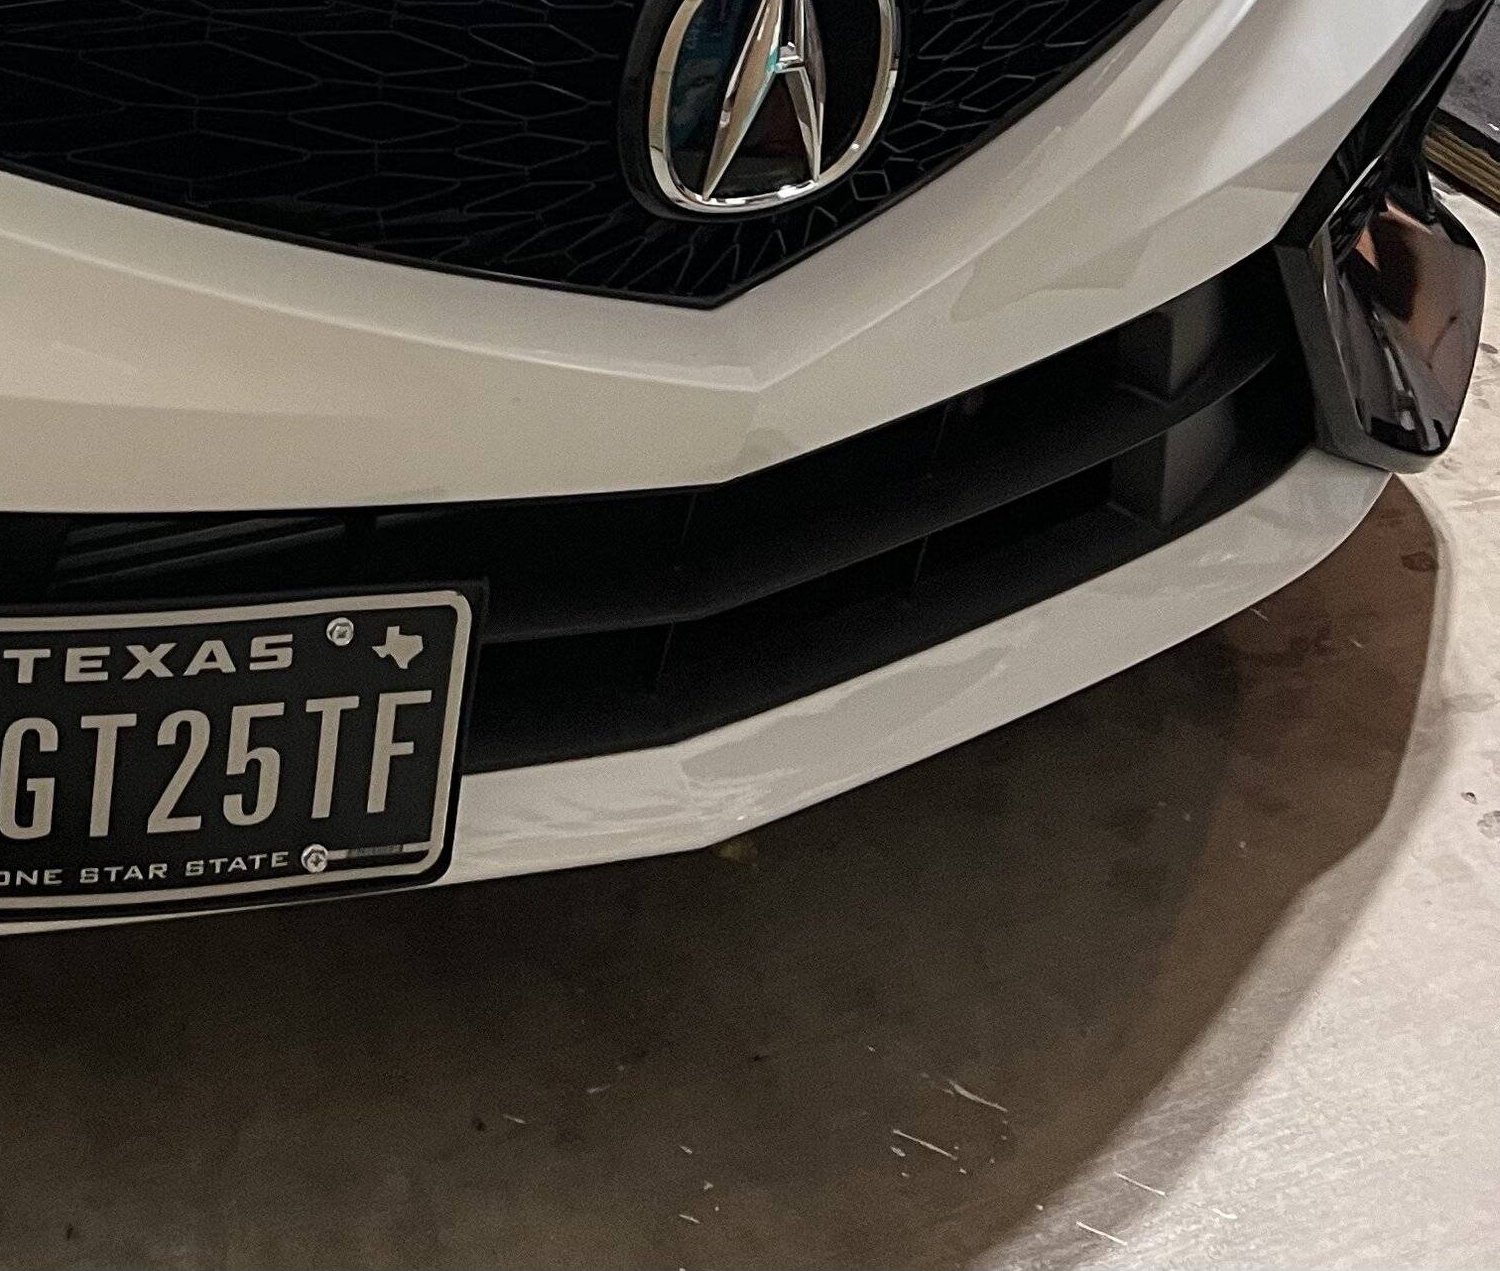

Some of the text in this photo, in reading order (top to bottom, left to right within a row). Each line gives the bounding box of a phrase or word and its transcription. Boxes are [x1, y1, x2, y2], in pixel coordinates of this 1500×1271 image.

[3, 633, 294, 685] TEXAS
[79, 863, 168, 885] STAR
[185, 851, 290, 874] STATE
